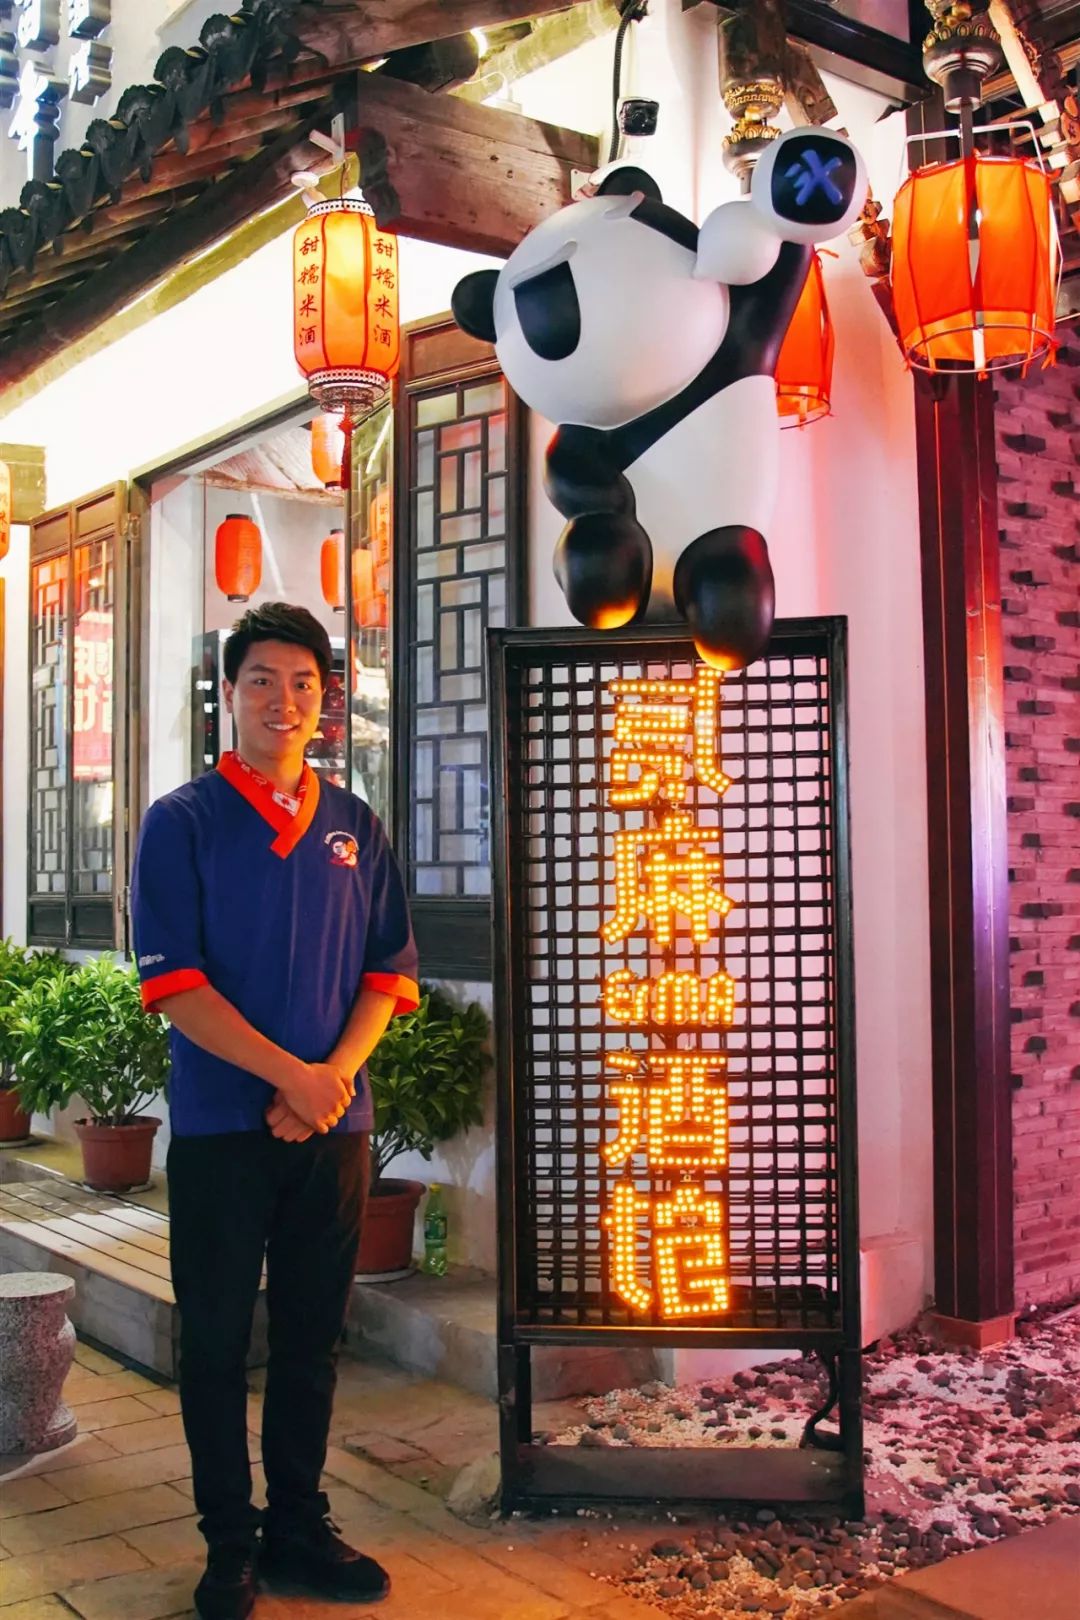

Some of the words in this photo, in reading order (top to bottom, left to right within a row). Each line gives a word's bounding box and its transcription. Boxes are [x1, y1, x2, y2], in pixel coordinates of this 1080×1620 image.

[298, 236, 320, 346] 甜糯米酒
[372, 238, 395, 347] 甜糯米酒
[602, 1052, 730, 1319] 酒馆
